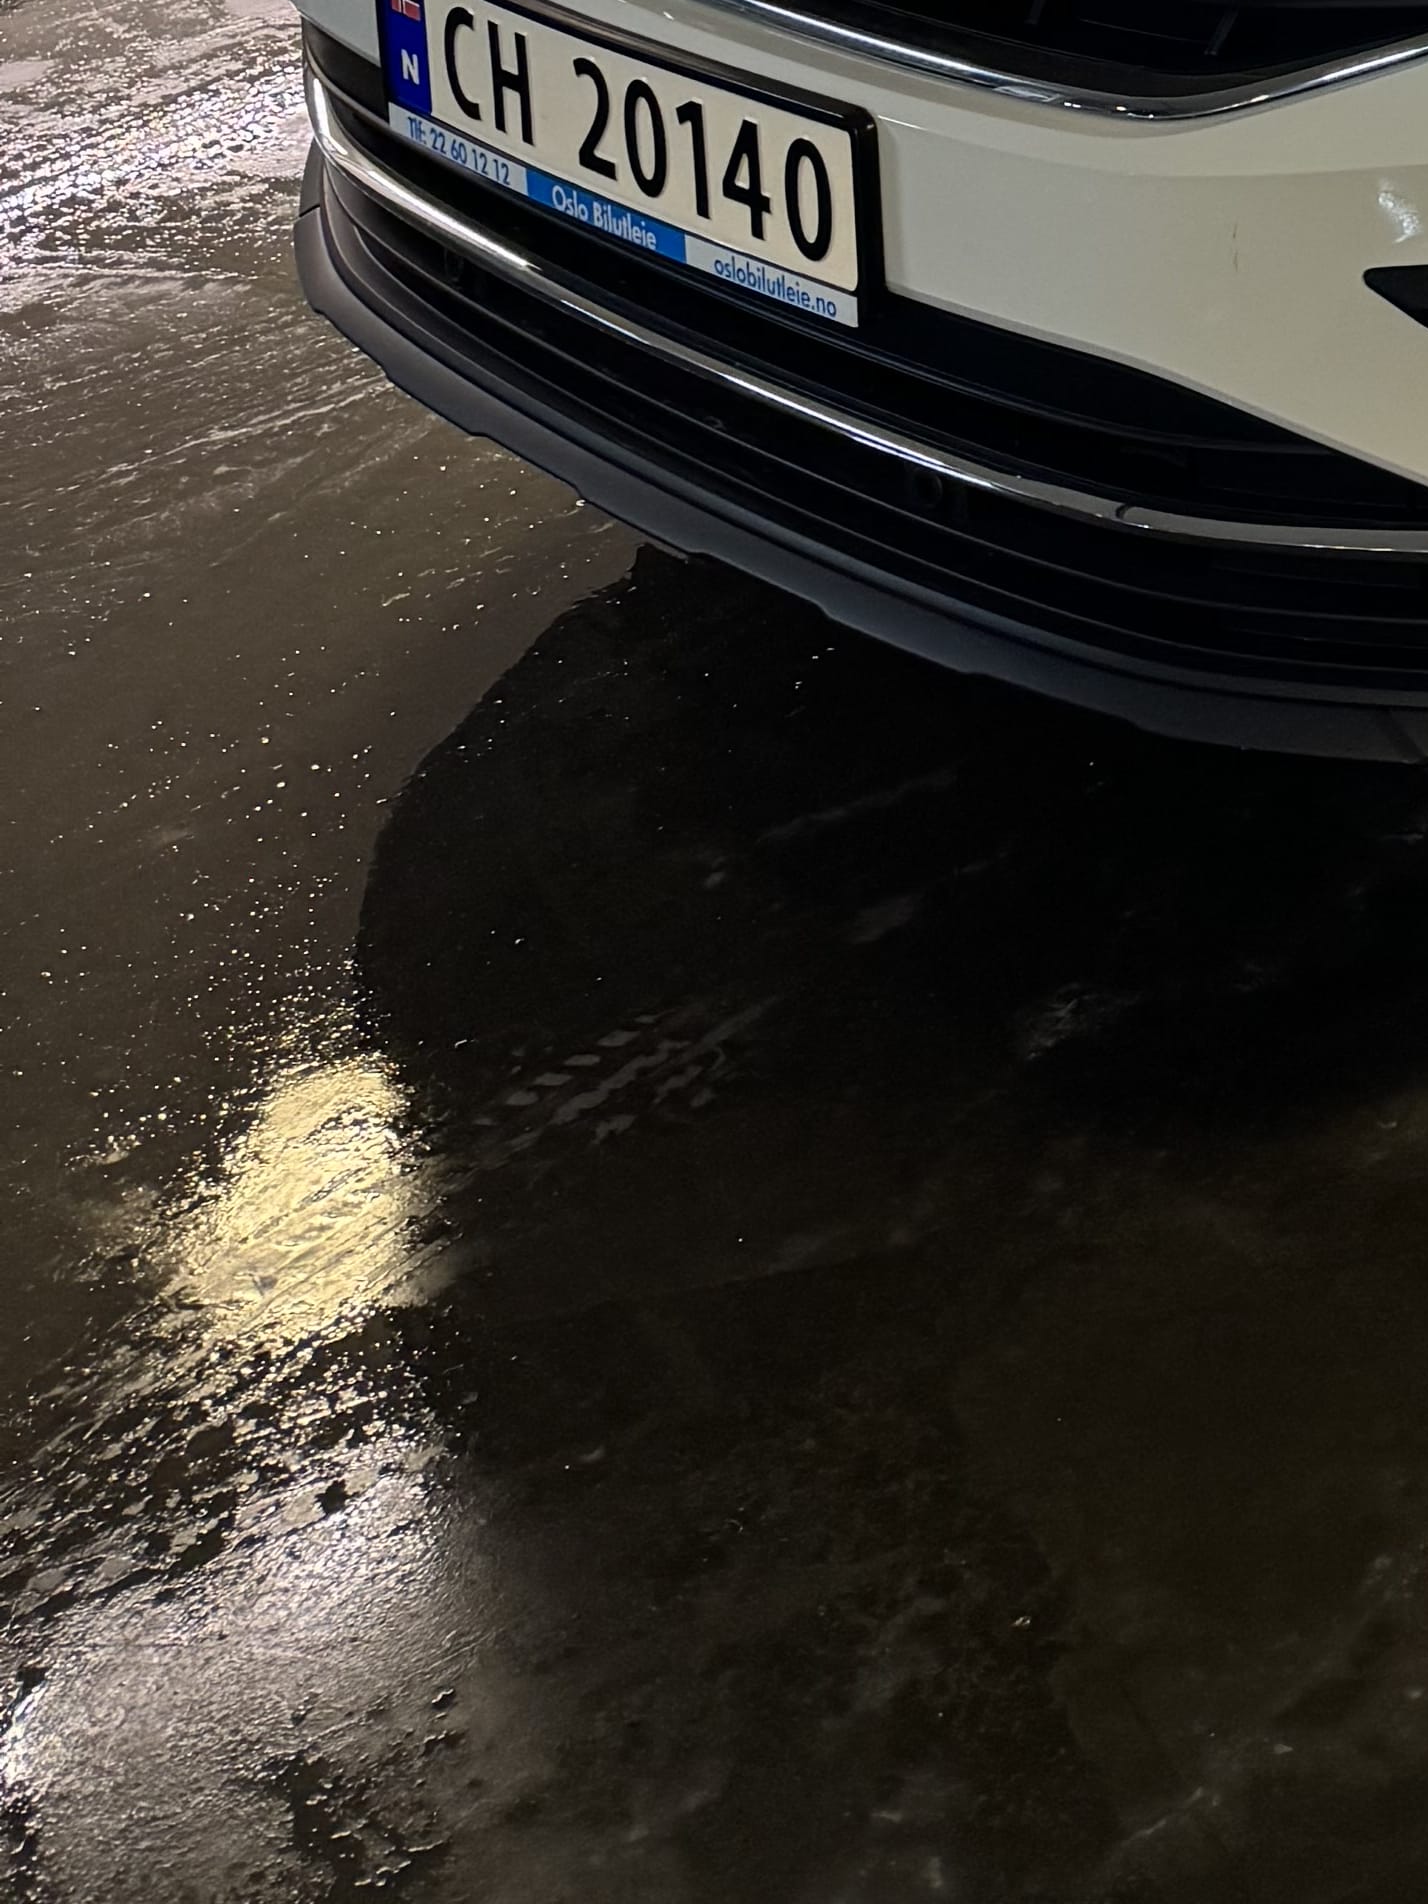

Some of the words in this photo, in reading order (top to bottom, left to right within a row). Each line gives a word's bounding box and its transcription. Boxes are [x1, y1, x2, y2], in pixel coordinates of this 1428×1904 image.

[400, 48, 420, 85] N
[408, 116, 427, 145] Tlf:
[430, 127, 447, 154] 22
[451, 139, 467, 165] 60
[472, 148, 488, 176] 12
[493, 158, 510, 185] 12
[444, 6, 535, 147] CH
[573, 56, 833, 261] 20140
[552, 184, 589, 222] Oslo
[592, 200, 657, 250] Bilutleie
[714, 255, 837, 318] oslobilutleie.no
